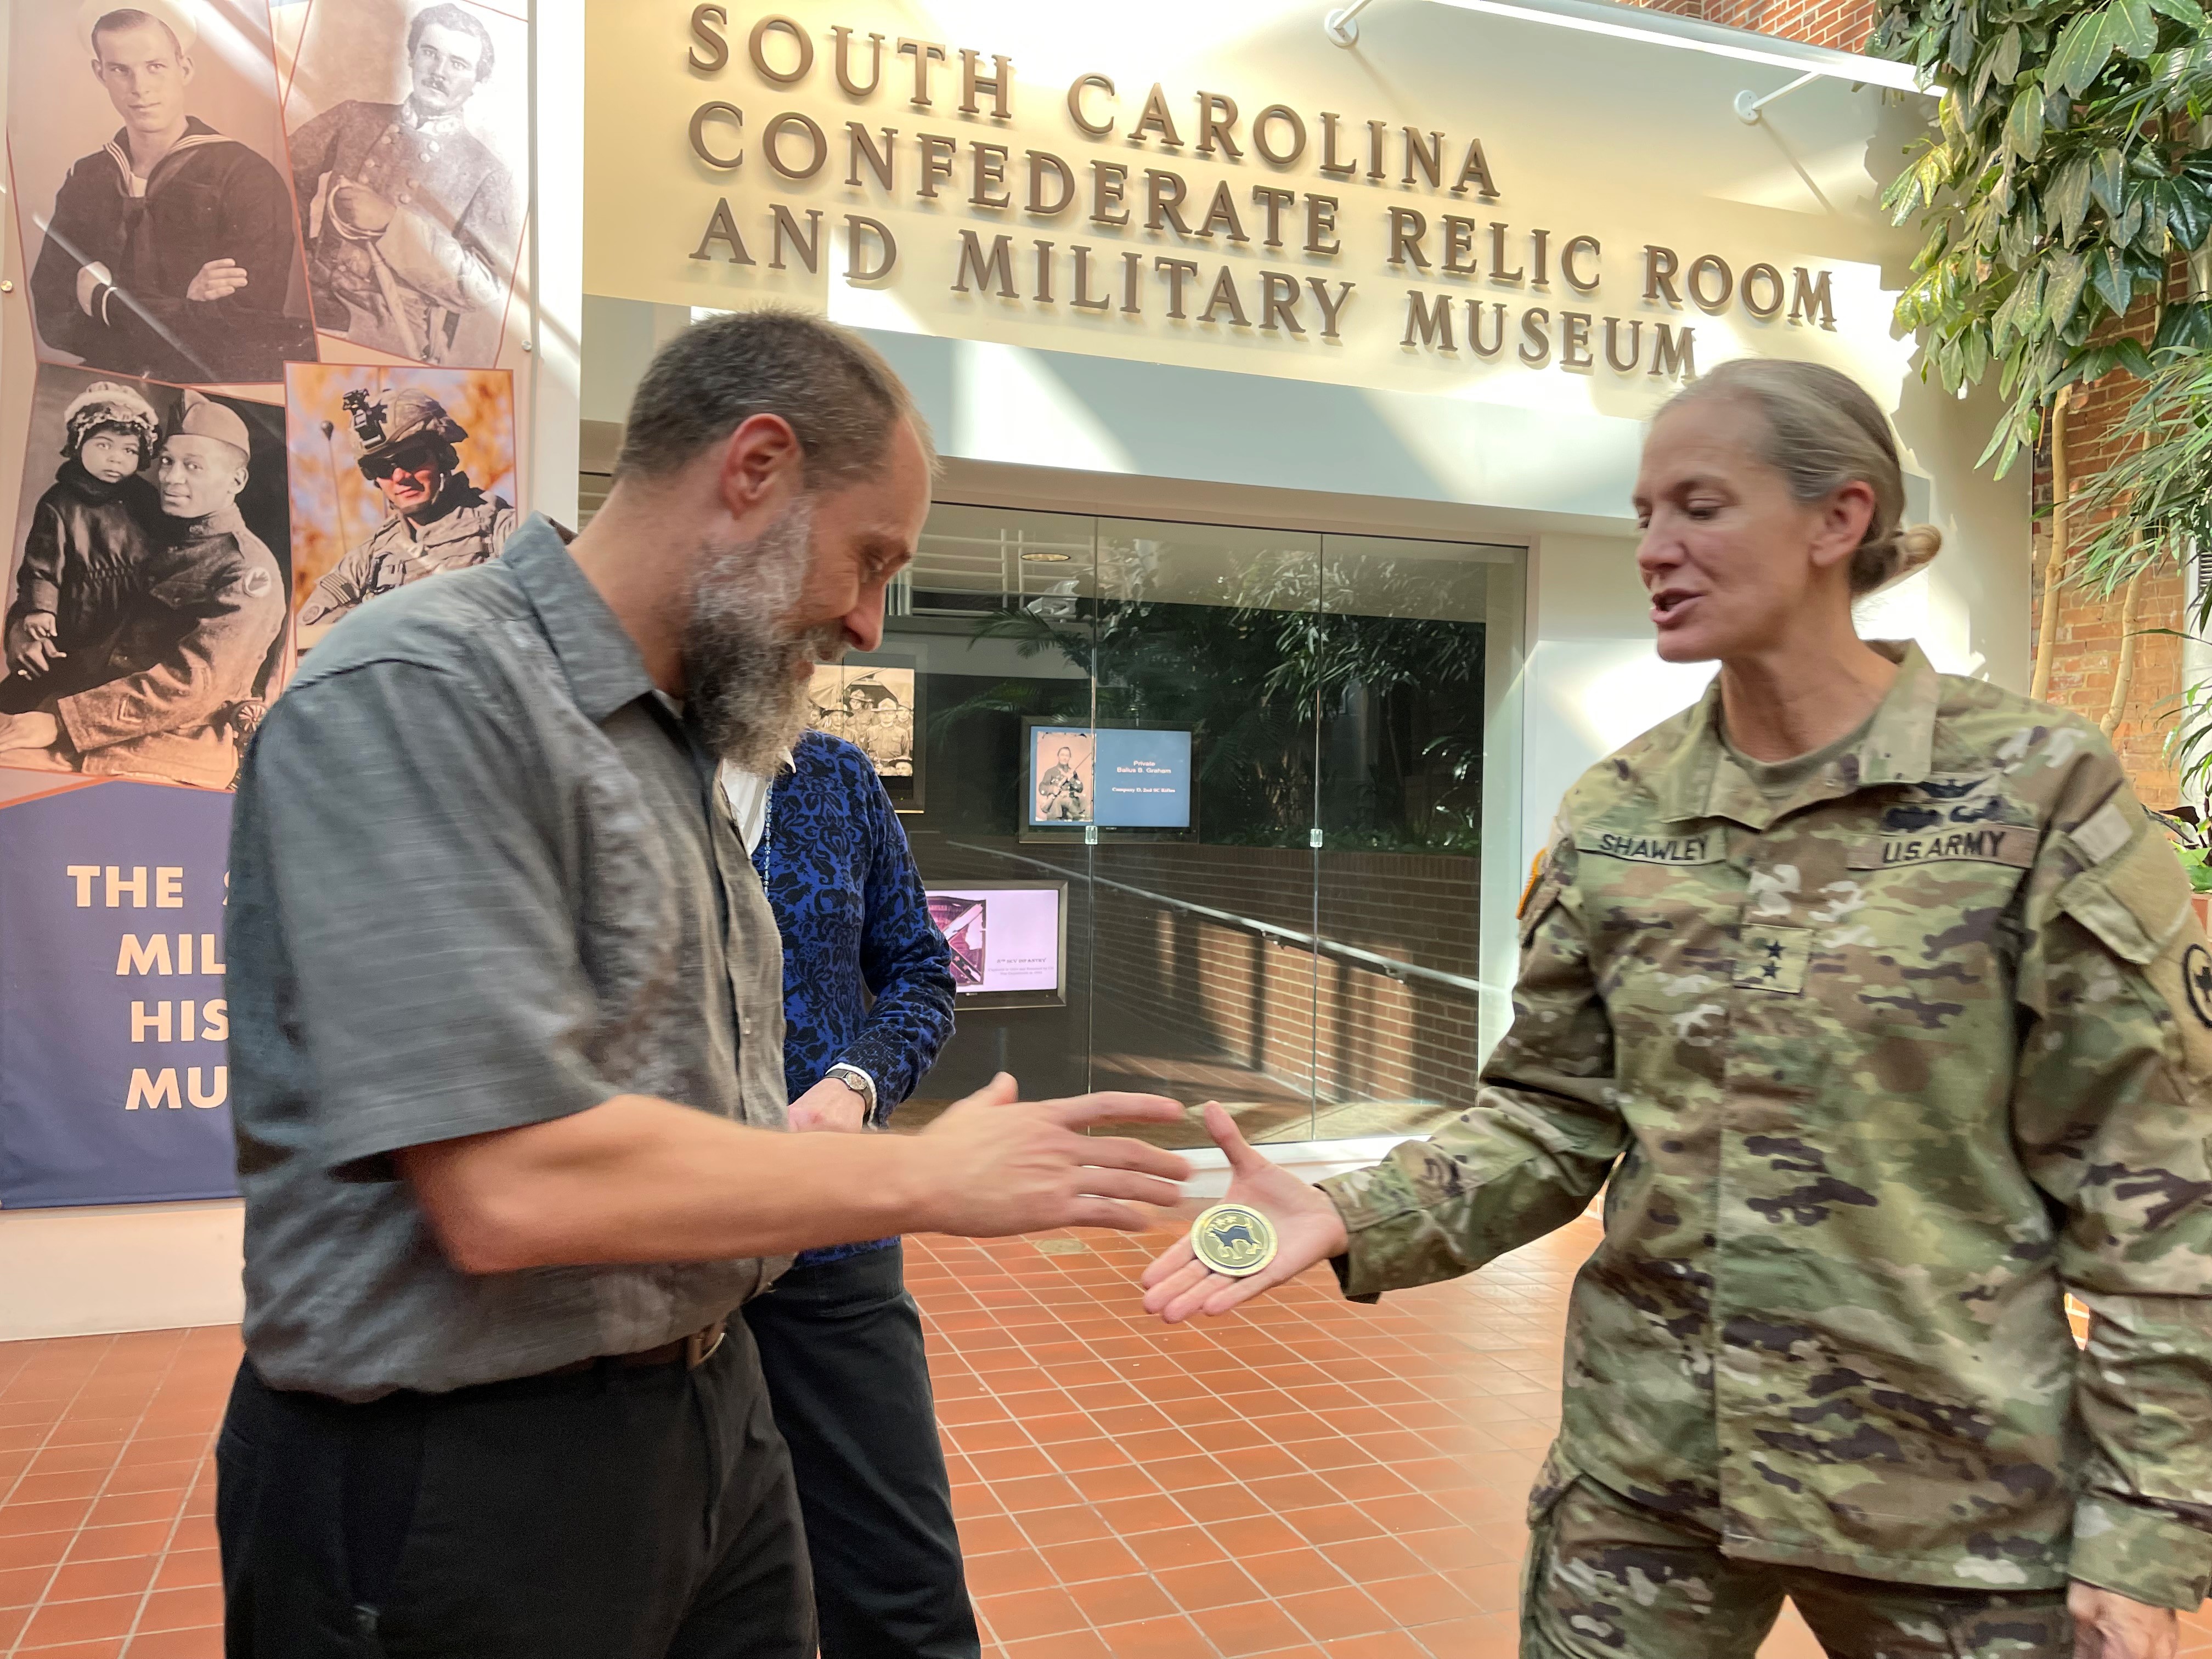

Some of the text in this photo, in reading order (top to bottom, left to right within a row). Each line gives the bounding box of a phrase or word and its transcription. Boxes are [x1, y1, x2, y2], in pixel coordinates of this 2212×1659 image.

[689, 3, 1501, 197] SOUTH CAROLINA
[689, 100, 1837, 323] CONFEDERATE RELIC ROOM
[689, 198, 1697, 381] AND MILITARY MUSEUM
[1598, 833, 1709, 861] SHAWLEY
[1925, 830, 2006, 857] ARMY
[66, 865, 184, 908] THE
[116, 934, 227, 975] MIL
[131, 999, 229, 1042] HIS
[125, 1066, 228, 1110] MU
